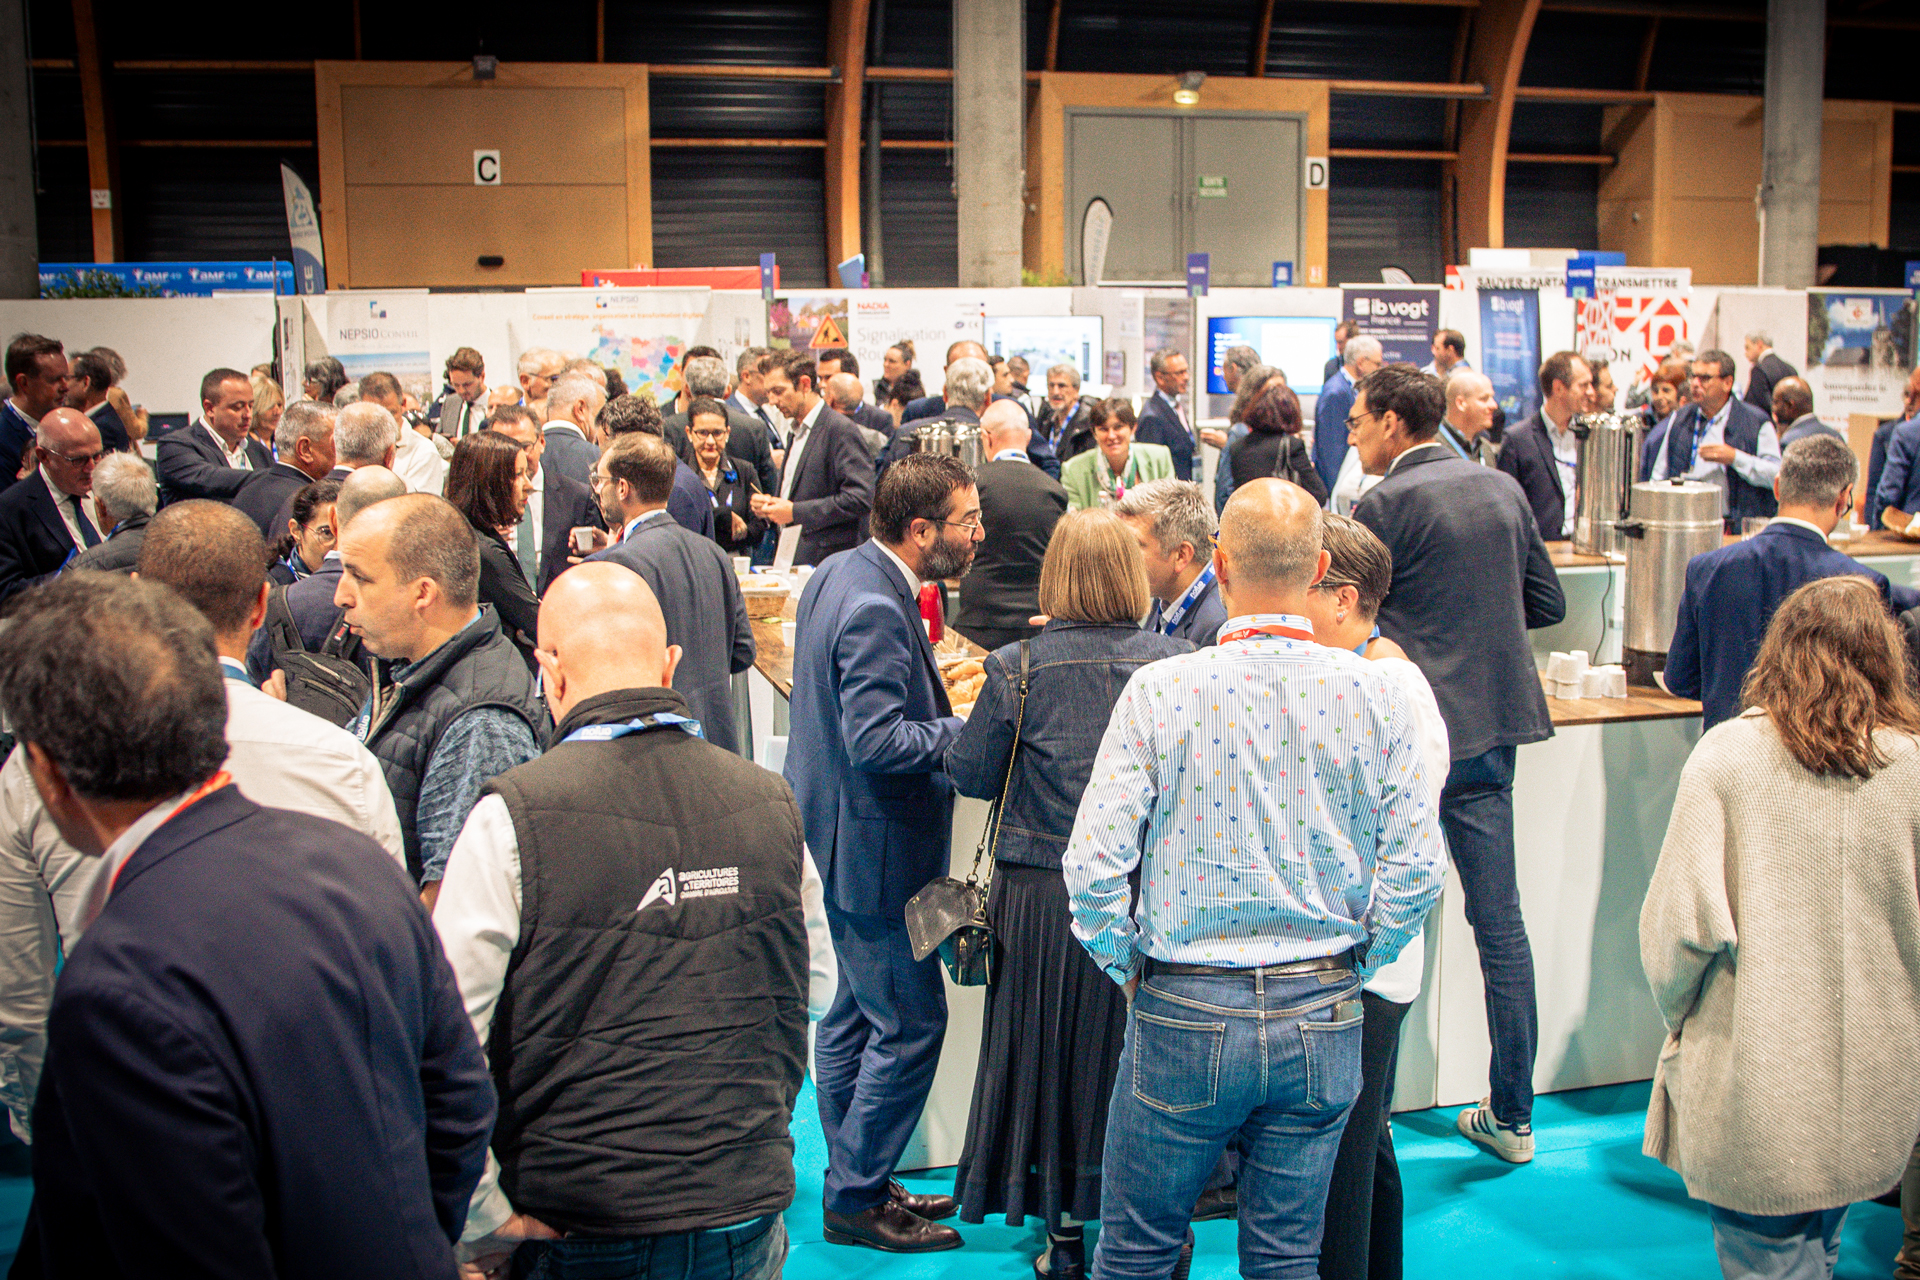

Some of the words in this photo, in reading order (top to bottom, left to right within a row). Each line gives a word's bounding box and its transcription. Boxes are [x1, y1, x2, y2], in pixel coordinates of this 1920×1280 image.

[478, 156, 497, 182] C
[1310, 162, 1325, 186] D
[1388, 299, 1430, 320] vogt
[339, 328, 379, 341] NEPSIO
[857, 326, 946, 345] Signalisation
